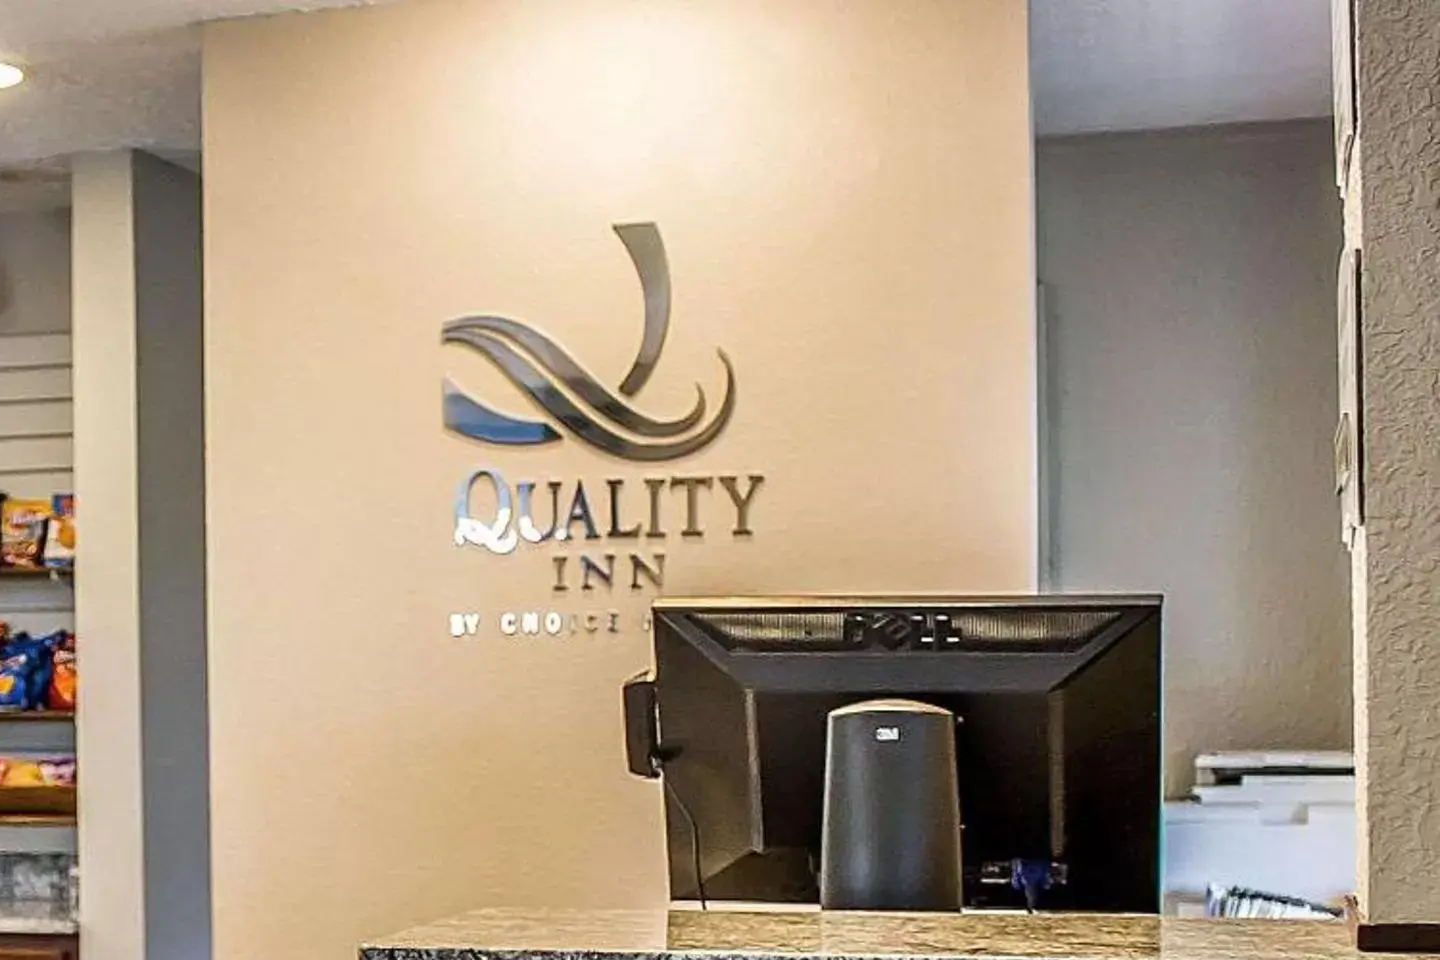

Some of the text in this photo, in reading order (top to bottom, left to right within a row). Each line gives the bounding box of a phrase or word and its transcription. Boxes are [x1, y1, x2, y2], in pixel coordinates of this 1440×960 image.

[454, 469, 764, 554] QUALITY
[552, 554, 665, 591] INN
[449, 612, 480, 637] BY
[844, 612, 961, 649] DELL
